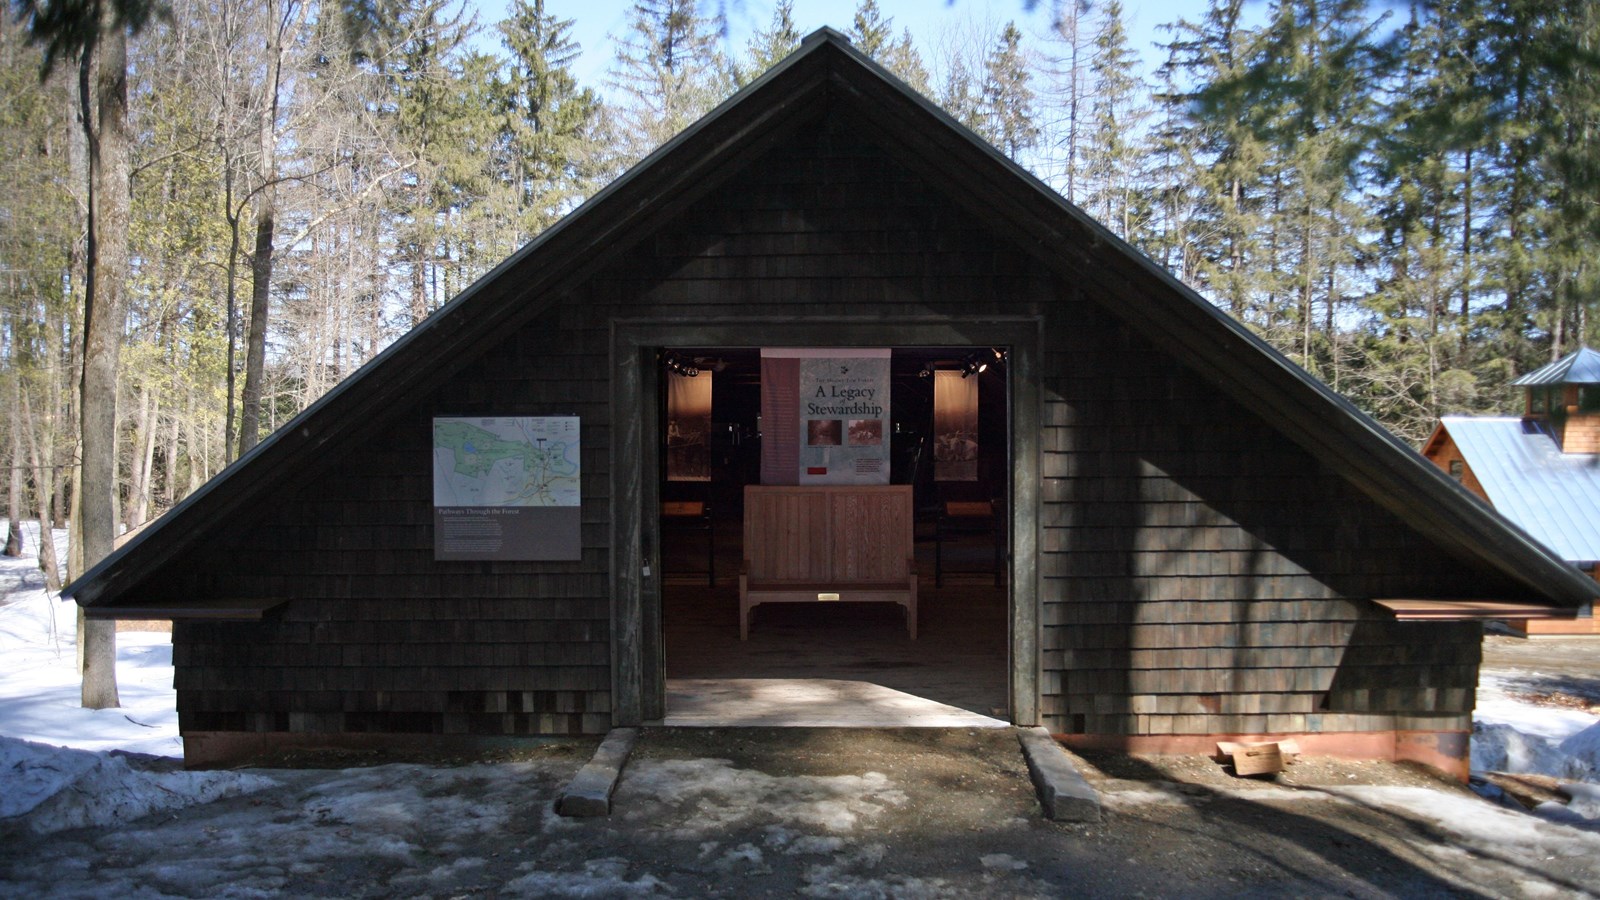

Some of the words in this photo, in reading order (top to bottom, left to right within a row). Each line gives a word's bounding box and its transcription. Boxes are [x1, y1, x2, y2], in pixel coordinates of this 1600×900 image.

[815, 385, 826, 398] A
[831, 386, 875, 401] Legacy
[807, 402, 883, 418] Stewardship
[438, 508, 465, 516] Pathways
[466, 508, 491, 516] Through
